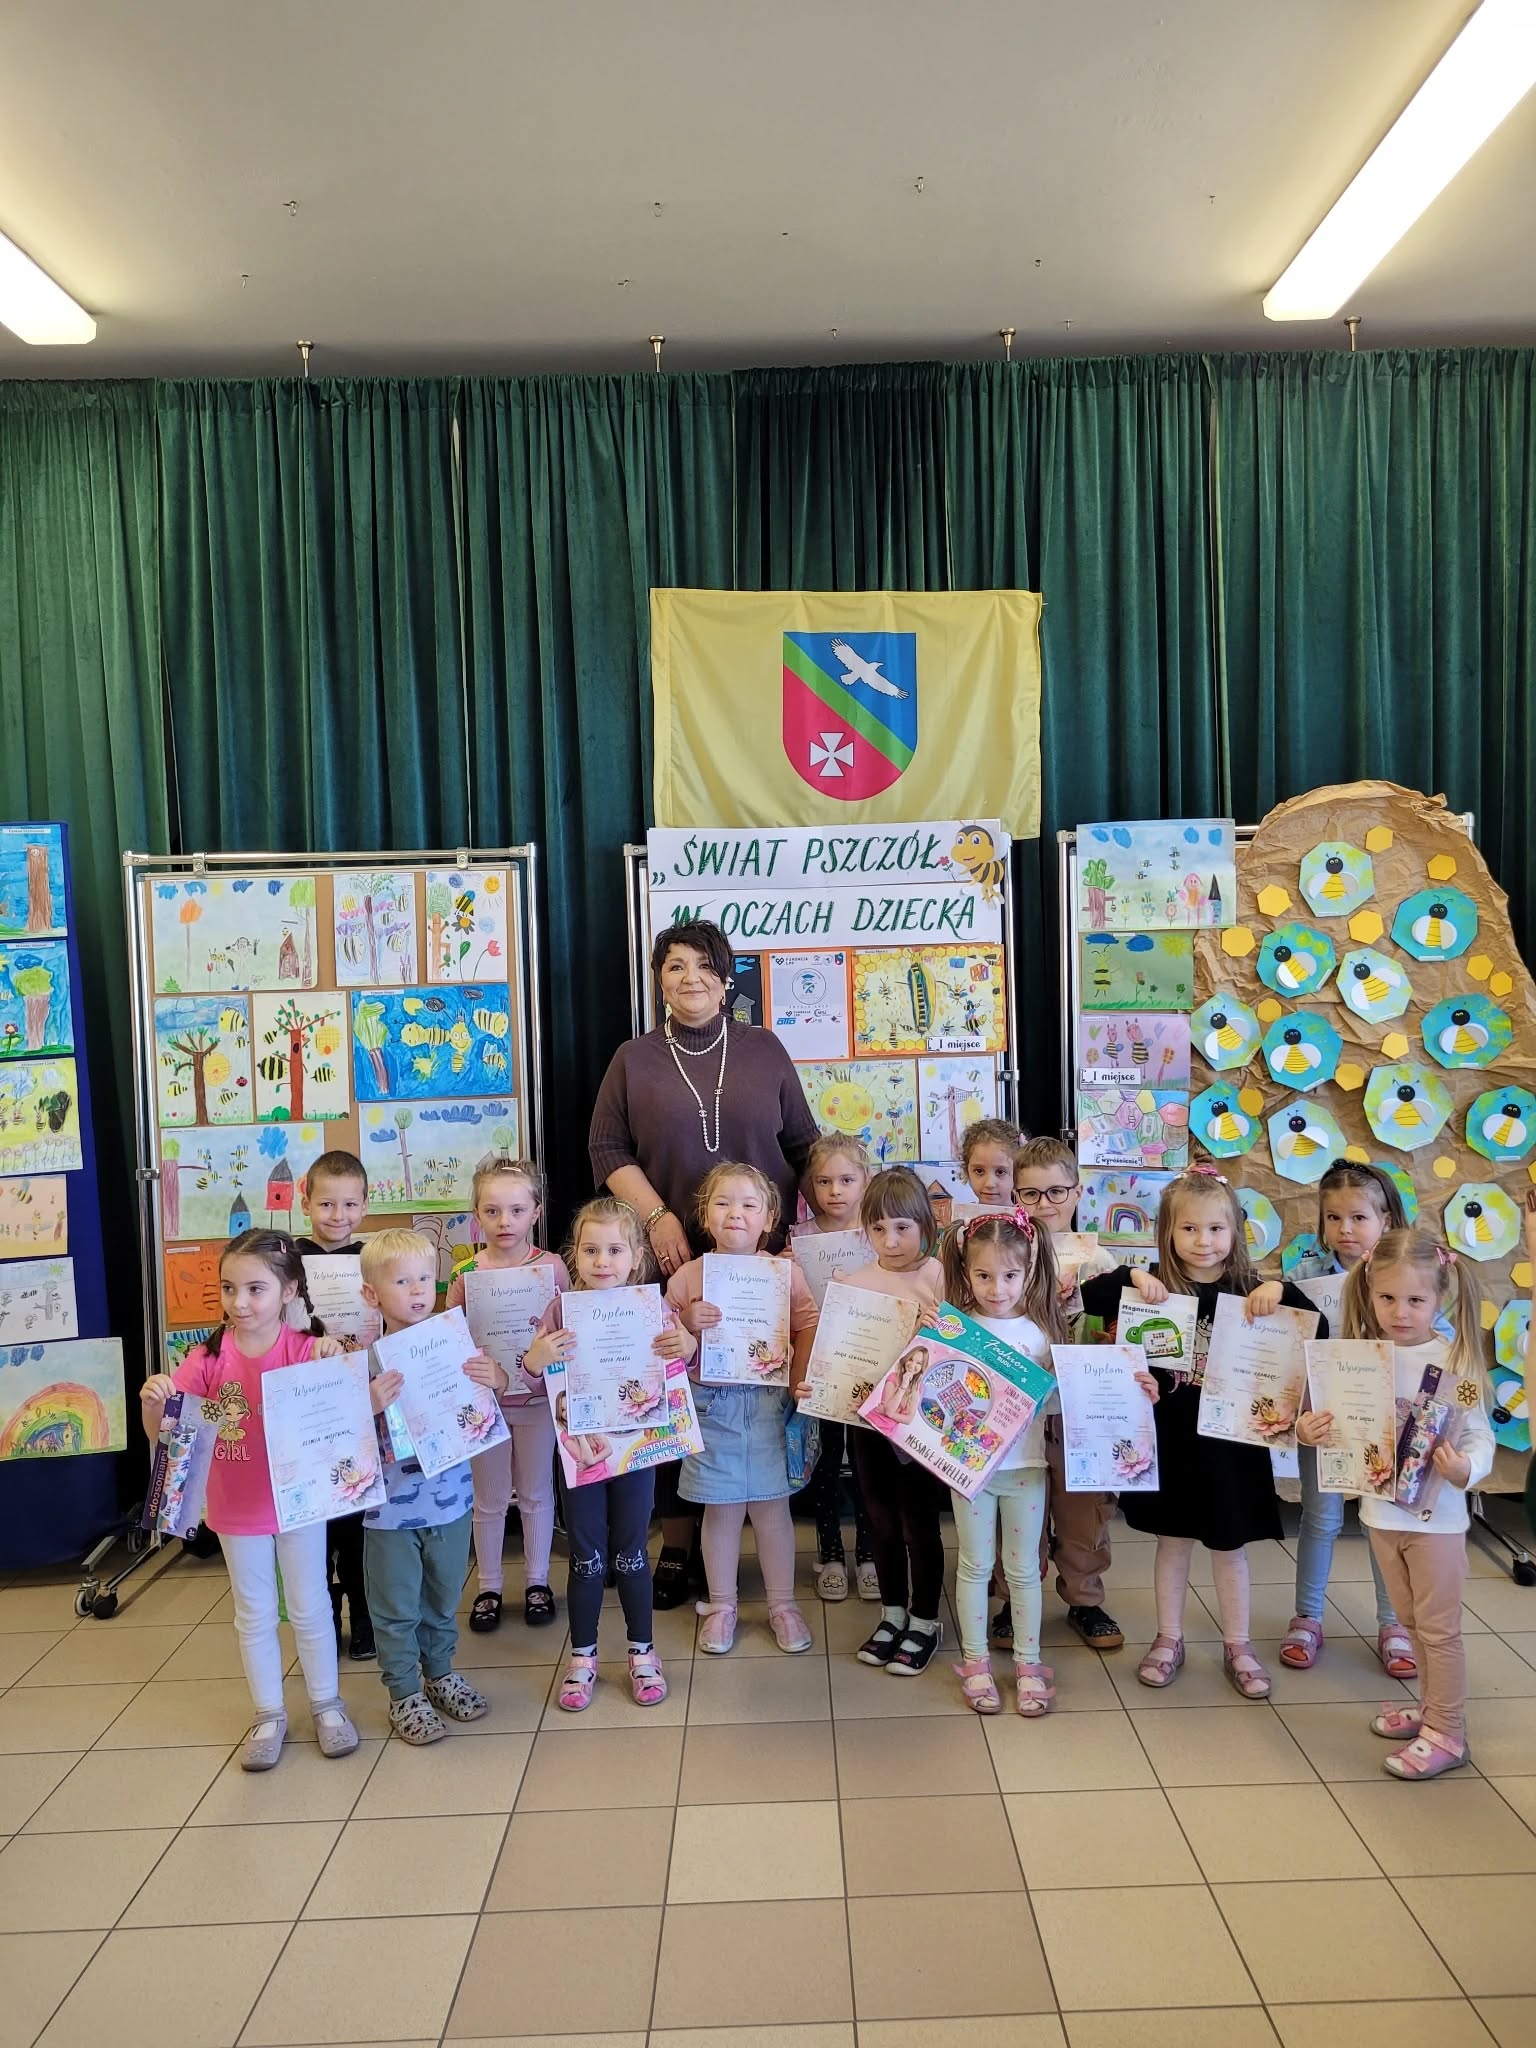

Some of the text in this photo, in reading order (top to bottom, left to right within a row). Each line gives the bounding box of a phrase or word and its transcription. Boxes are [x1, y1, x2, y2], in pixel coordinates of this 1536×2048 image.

[720, 900, 835, 938] OCZACH
[851, 895, 978, 939] DZIECKA
[947, 1040, 981, 1051] miejsce
[1101, 1071, 1136, 1083] miejsce
[818, 1248, 855, 1262] Dyplom
[592, 1306, 635, 1322] Dyplom
[1122, 1304, 1160, 1315] Magnetism
[410, 1337, 448, 1359] Dyplom
[983, 1339, 1029, 1373] Fashion
[1084, 1362, 1123, 1376] Dyplom
[214, 1443, 251, 1461] GIRL
[632, 1437, 682, 1458] MESSAGE
[627, 1444, 692, 1470] JEWELLERY
[905, 1434, 973, 1489] MESSAGE JEWELLERY
